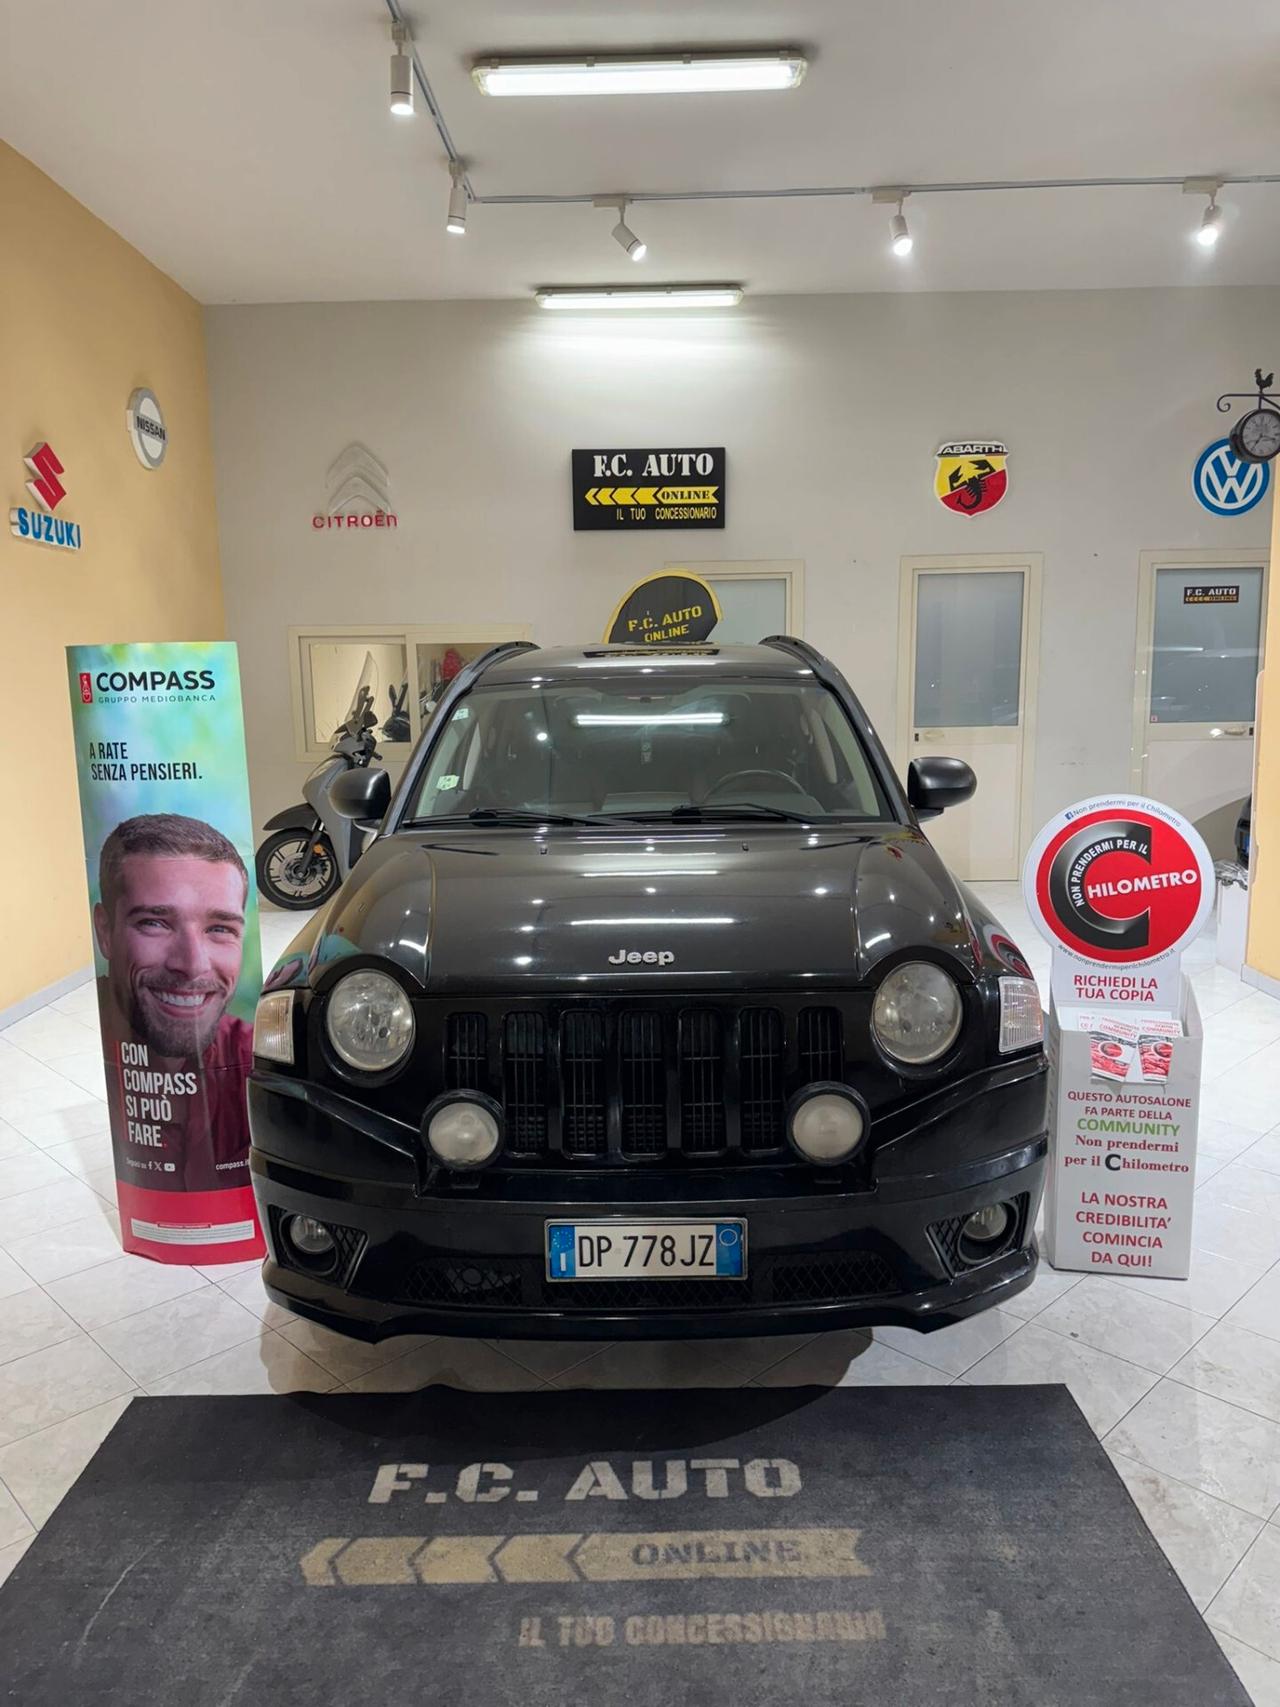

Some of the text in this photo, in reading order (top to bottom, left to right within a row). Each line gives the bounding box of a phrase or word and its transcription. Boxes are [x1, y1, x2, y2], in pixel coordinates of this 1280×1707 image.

[136, 416, 166, 440] NISSAN
[943, 445, 1002, 454] ABARTH
[593, 453, 714, 477] F.C. AUTO
[661, 490, 710, 500] ONLINE
[616, 507, 717, 520] IL TUO CONCESSIONARIO
[17, 507, 81, 549] SUZUKI
[627, 605, 702, 632] F.C. AUTO
[644, 625, 689, 642] ONLINE
[96, 670, 215, 692] COMPASS
[98, 694, 216, 704] GRUPPO MEDIOBANCA
[89, 742, 128, 760] A RATE
[91, 762, 203, 781] SENZA PENSIERI.
[1073, 807, 1088, 817] Non
[1089, 799, 1126, 810] prendermi
[1127, 800, 1140, 808] per
[1146, 804, 1181, 827] Chilometro
[1071, 839, 1149, 908] NON PRENDERMI PER IL
[608, 949, 675, 966] Jeep
[1074, 975, 1158, 989] RICHIEDI LA
[1076, 988, 1155, 1002] TUA COPIA
[121, 1042, 149, 1067] CON
[123, 1069, 198, 1095] COMPASS
[125, 1094, 173, 1122] SI PUÒ
[1067, 1090, 1192, 1108] QUESTO AUTOSALONE
[1085, 1106, 1173, 1121] FA PARTE DELLA
[1077, 1118, 1180, 1137] COMMUNITY
[1075, 1135, 1179, 1152] Non prendermi
[1064, 1153, 1189, 1173] per il Chilometro
[1081, 1192, 1168, 1209] LA NOSTRA
[1082, 1231, 1163, 1248] COMINCIA
[578, 1236, 612, 1267] DP
[1091, 1251, 1152, 1268] DA QUI!
[367, 1459, 803, 1504] F.C. AUTO
[632, 1540, 802, 1566] ONLINE
[518, 1616, 546, 1647] IL
[557, 1615, 614, 1647] TUO
